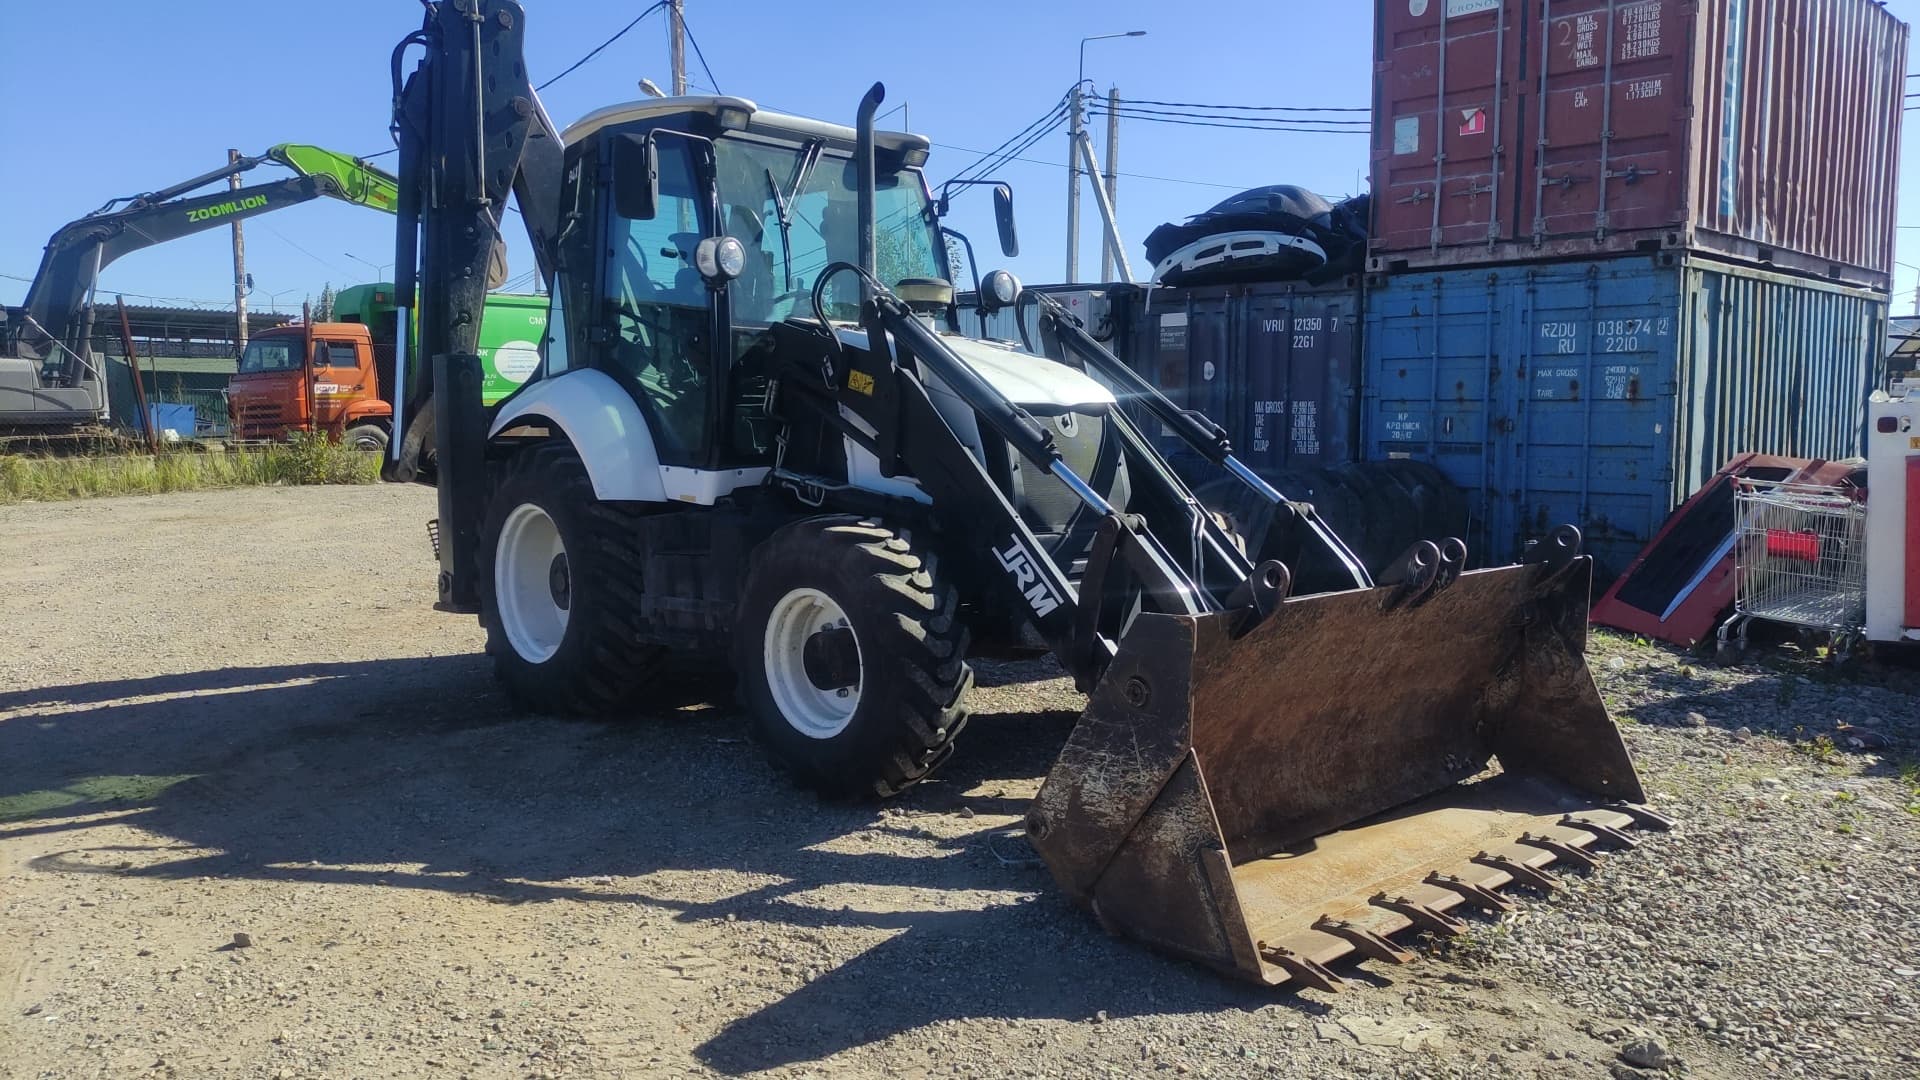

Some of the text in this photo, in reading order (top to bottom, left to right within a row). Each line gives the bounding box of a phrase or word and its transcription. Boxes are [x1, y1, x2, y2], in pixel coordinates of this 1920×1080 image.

[1577, 32, 1593, 41] TARE
[1576, 56, 1598, 68] CARGO
[186, 194, 268, 222] ZOOMLION
[1294, 317, 1322, 331] 121350
[1331, 317, 1338, 332] 7
[1541, 322, 1576, 337] RZDU
[1293, 335, 1314, 348] 22G1
[1558, 338, 1576, 353] RU
[1537, 368, 1552, 377] MAX
[1556, 368, 1578, 377] GROSS
[1537, 389, 1553, 398] TARE
[992, 533, 1064, 618] TRM
